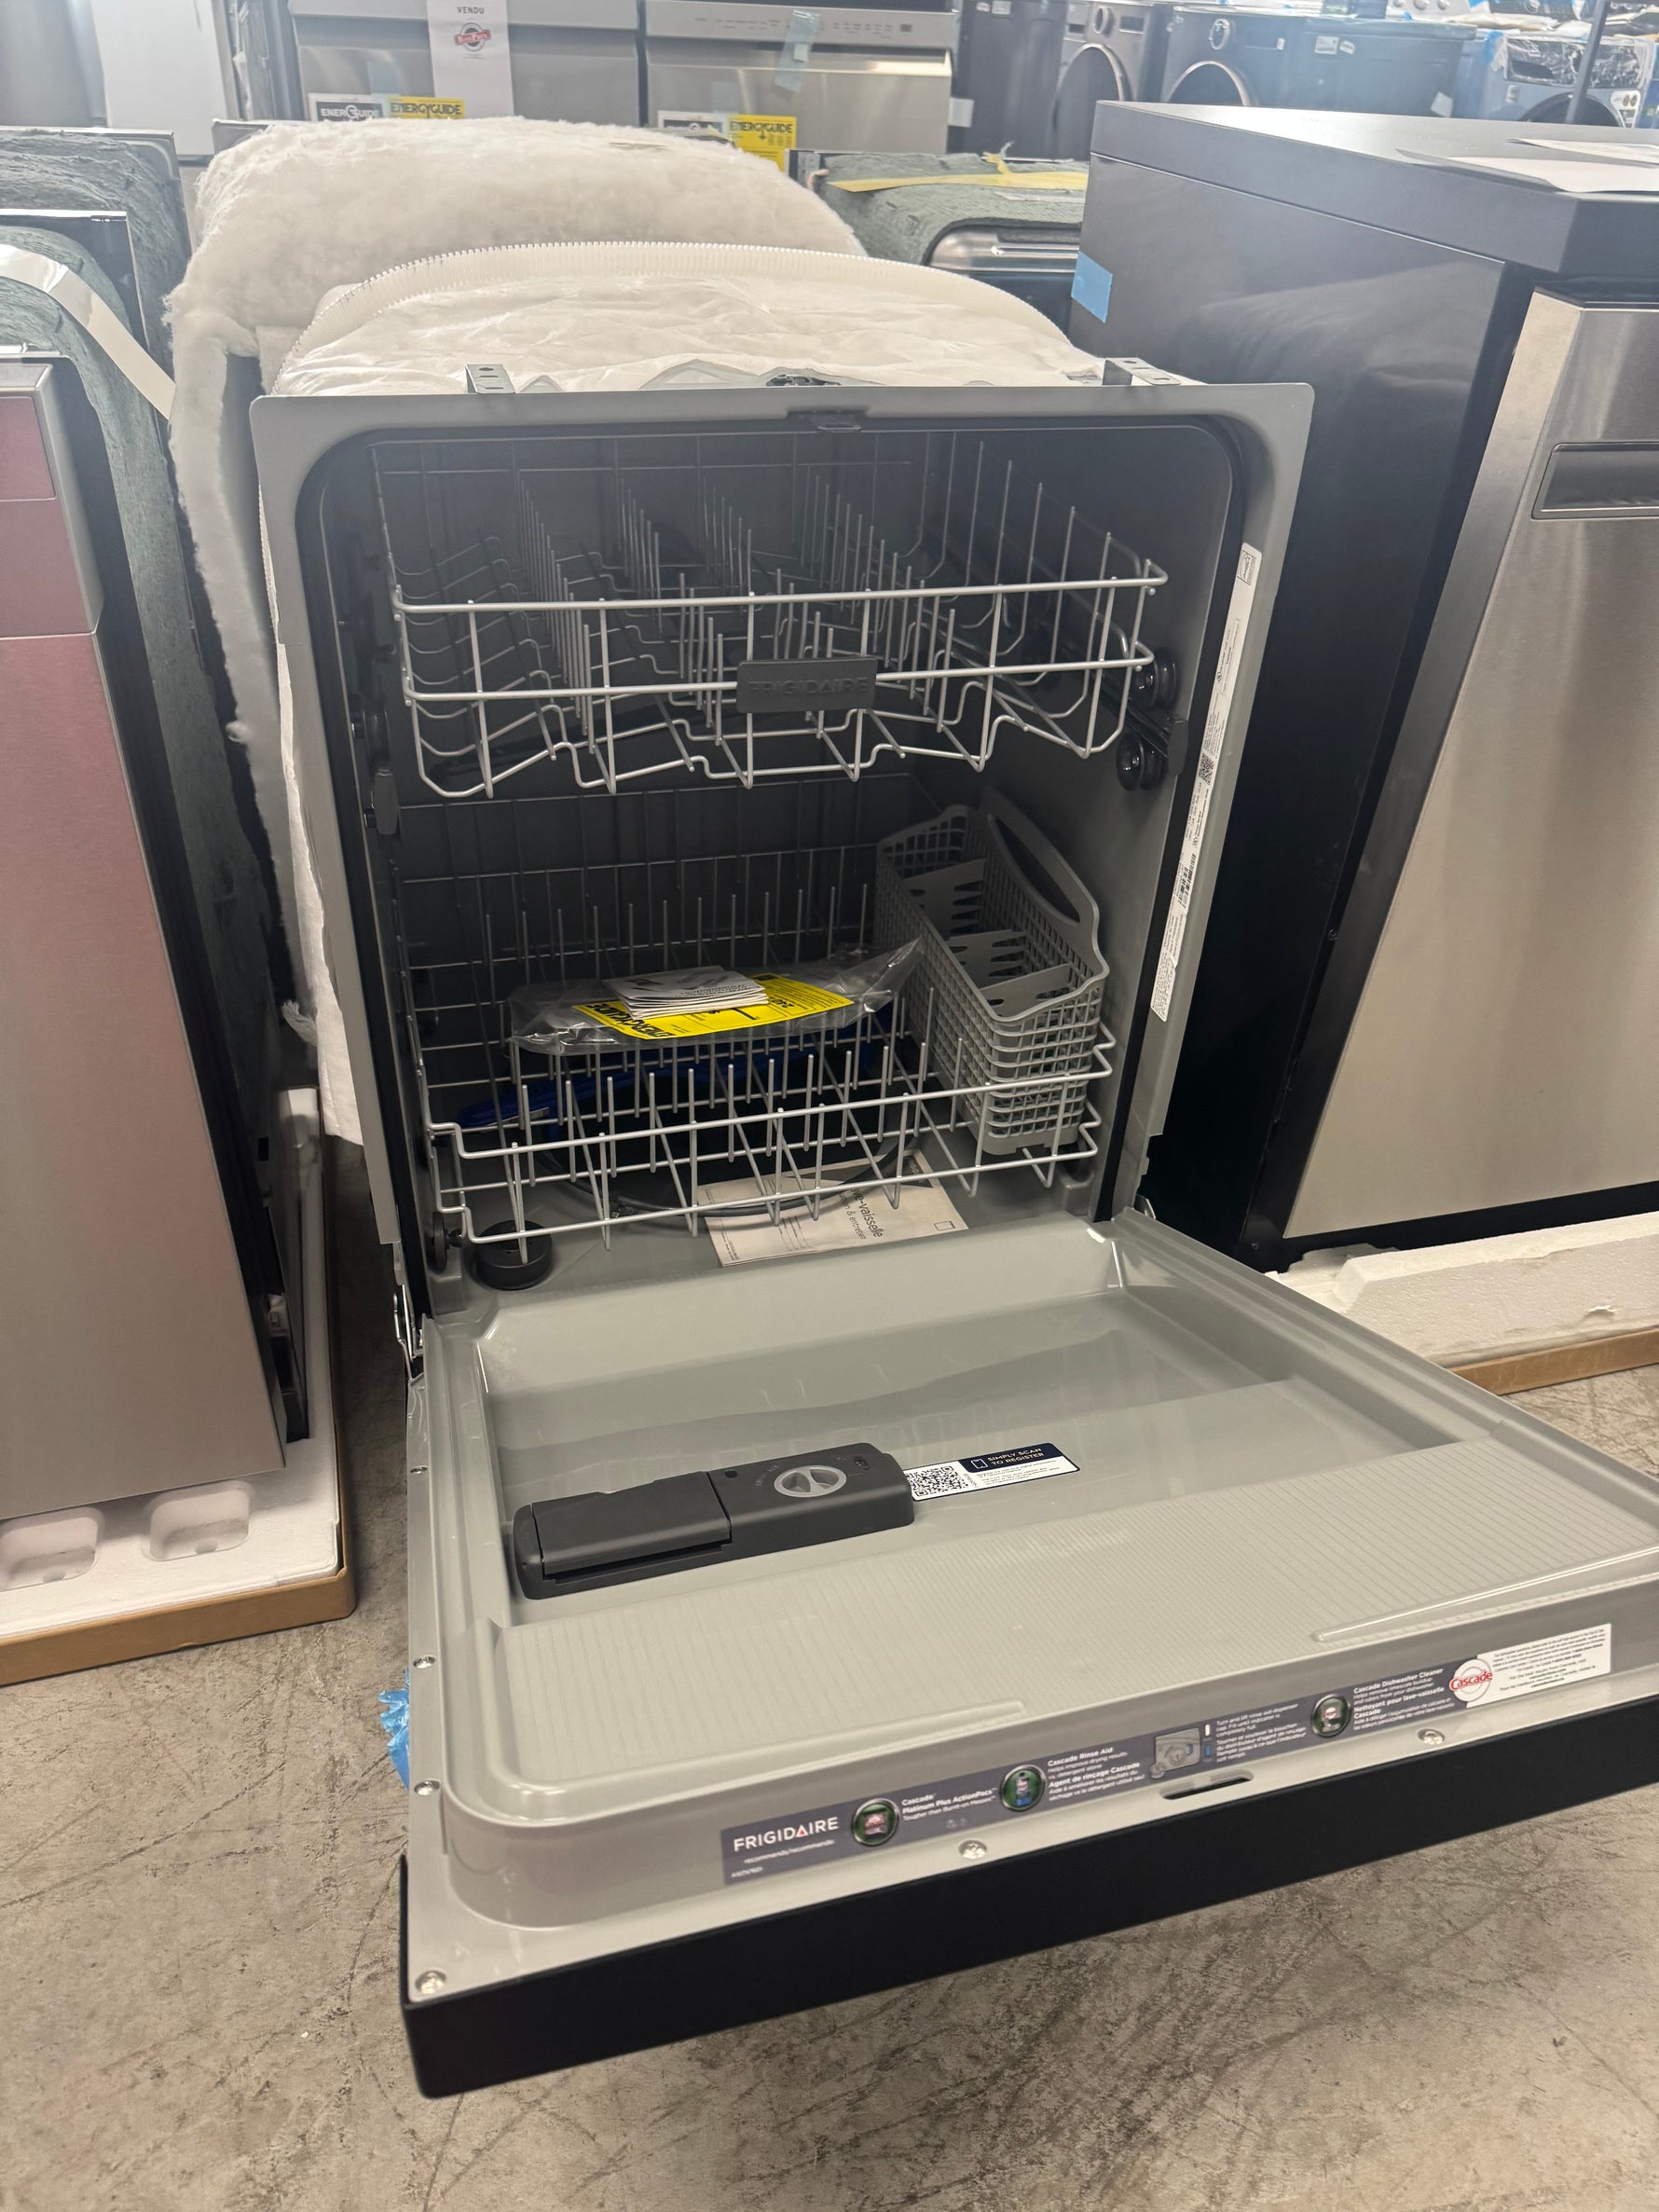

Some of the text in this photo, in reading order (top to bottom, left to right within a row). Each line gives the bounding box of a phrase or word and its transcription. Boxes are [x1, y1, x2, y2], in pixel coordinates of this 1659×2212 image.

[457, 6, 485, 14] VENDU
[390, 102, 461, 117] ENERGYGUIDE
[730, 121, 793, 134] ENERGYGUIDE
[747, 677, 870, 695] FRIGIDAIRE
[850, 1187, 884, 1238] ave-vaisselle
[987, 1451, 1016, 1462] SIMPLY
[1006, 1452, 1045, 1463] REGISTER
[1353, 1669, 1443, 1693] Cascade Dishwasher Cleaner
[1450, 1669, 1493, 1690] Cascade
[1354, 1688, 1445, 1712] Nettoyant pour lave-vaisselle
[1354, 1709, 1381, 1718] Cascade
[1048, 1755, 1077, 1765] Cascade
[1079, 1751, 1098, 1759] Rinse
[1049, 1779, 1070, 1787] Agent
[1083, 1770, 1109, 1779] rinçage
[1111, 1763, 1140, 1773] Cascade
[902, 1803, 934, 1814] Platinum
[936, 1798, 951, 1807] Plus
[734, 1817, 839, 1852] FRIGIDAIRE
